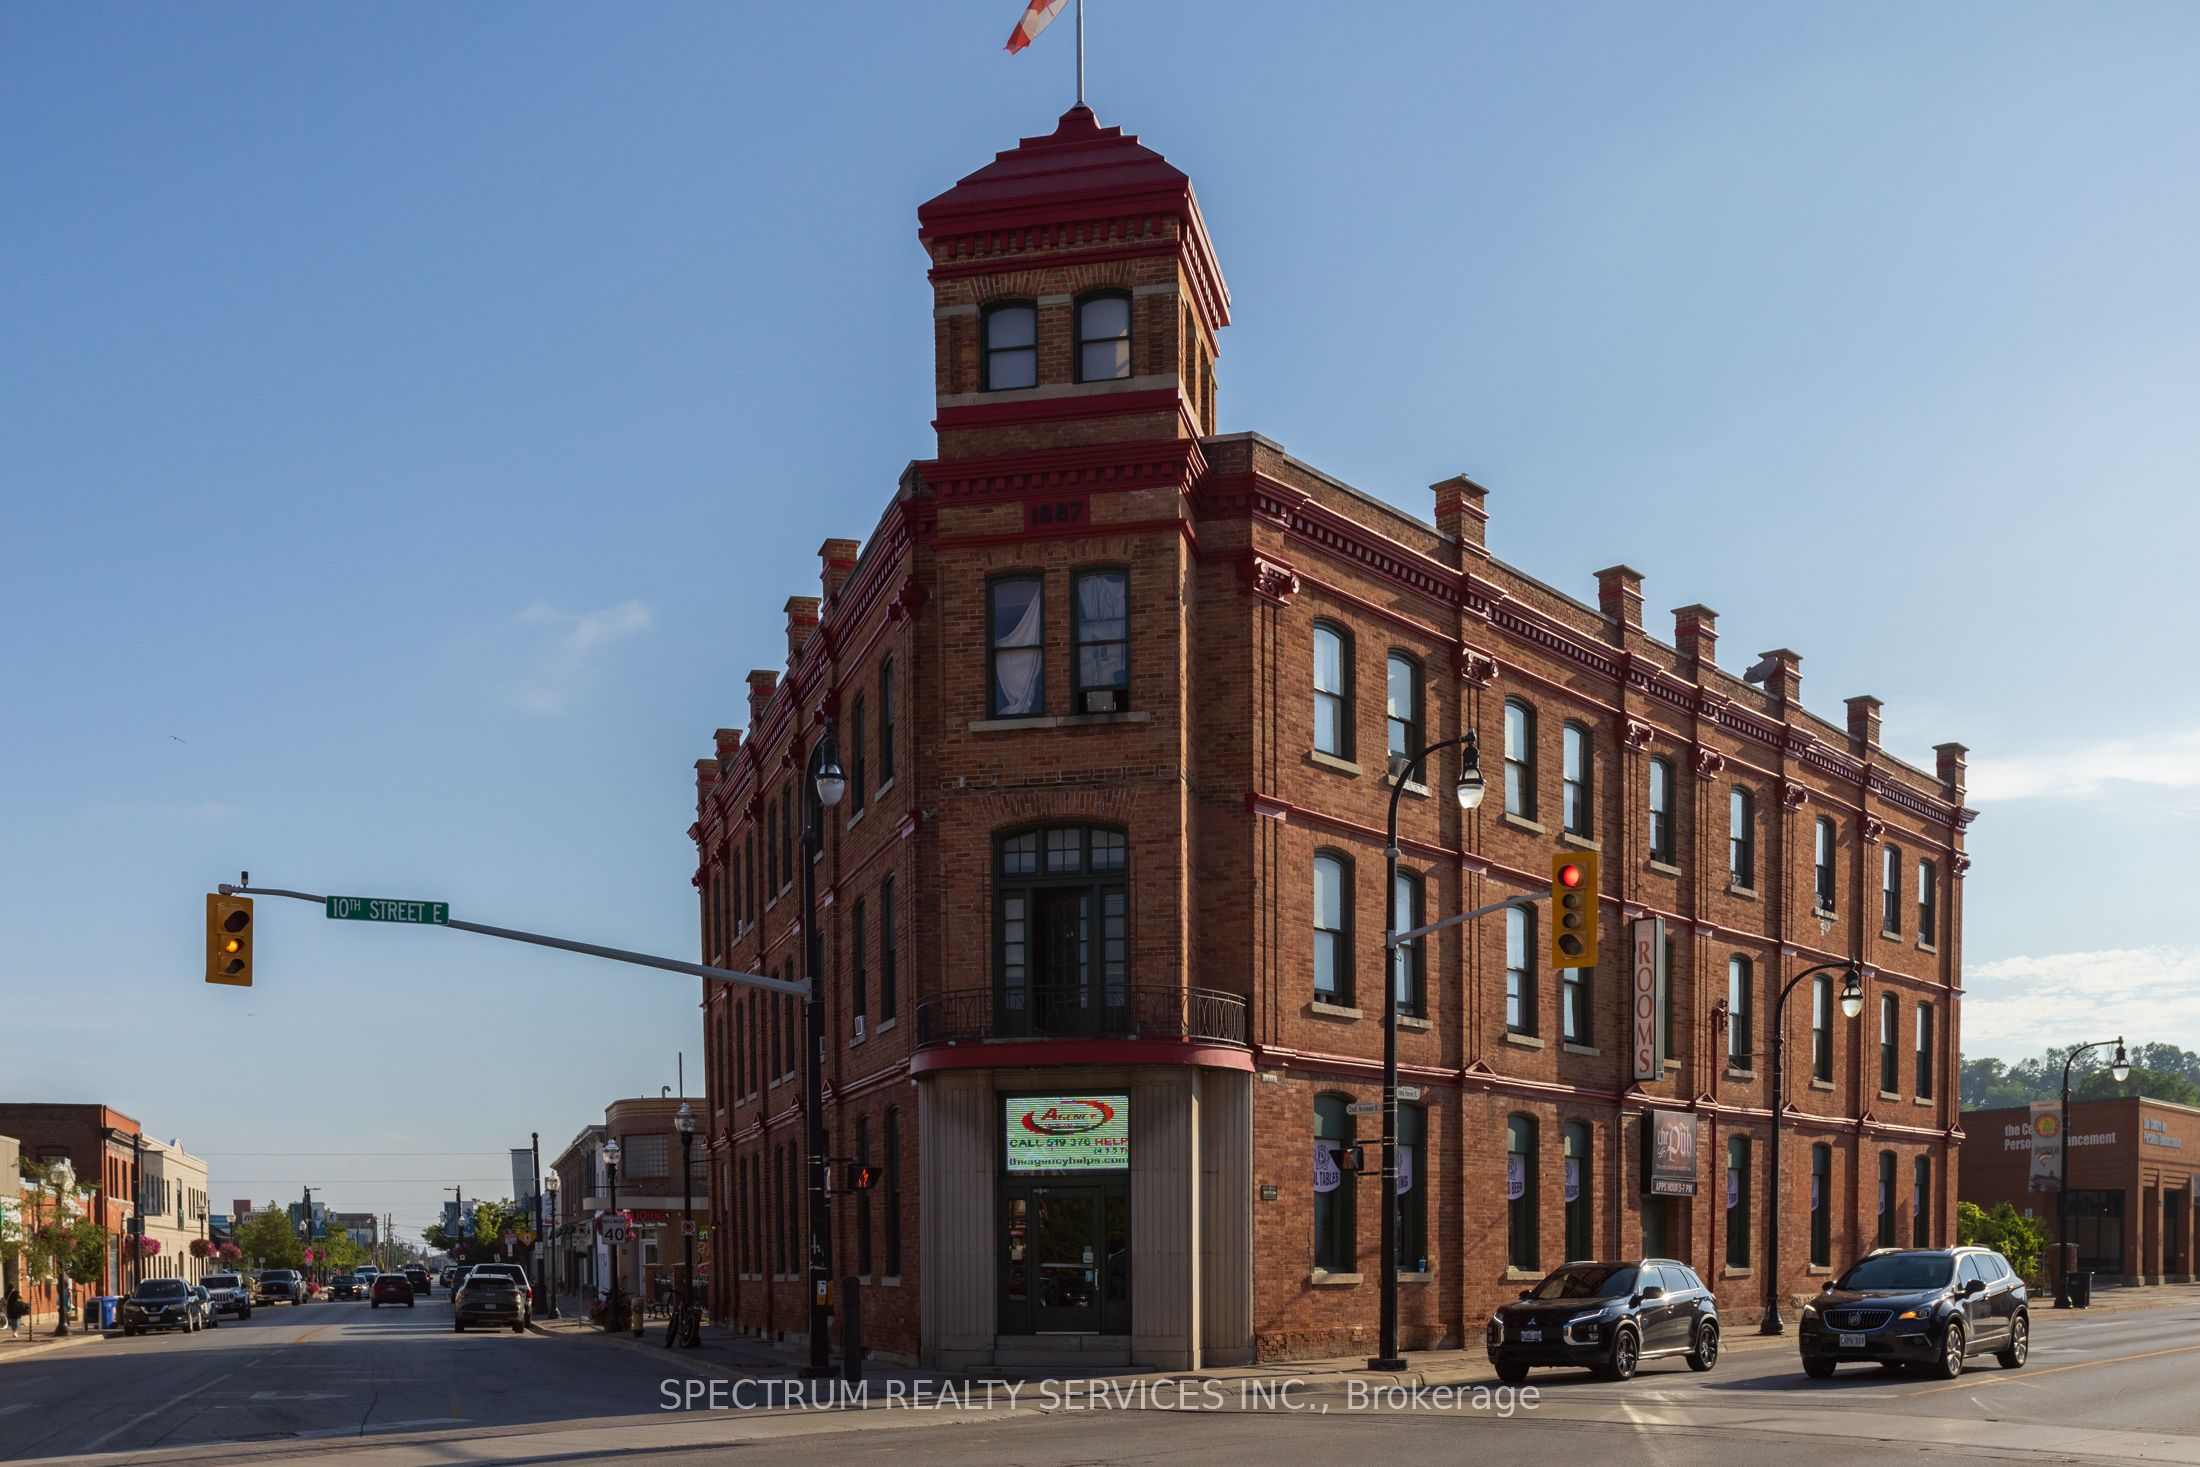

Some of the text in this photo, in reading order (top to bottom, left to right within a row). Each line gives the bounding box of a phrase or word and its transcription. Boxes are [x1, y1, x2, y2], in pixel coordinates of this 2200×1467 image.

[1030, 500, 1083, 526] 1887
[333, 898, 442, 923] 10TH STREET E
[1636, 940, 1654, 1073] ROOMS
[2004, 1124, 2020, 1137] the
[1009, 1138, 1128, 1148] CALL 519 376 HELP
[1667, 1122, 1692, 1162] Pub
[2004, 1138, 2032, 1151] Perso
[2067, 1131, 2117, 1147] ancement
[1009, 1157, 1128, 1167] theagencyhelps.com
[1319, 1171, 1339, 1187] TABLES
[1655, 1181, 1667, 1192] APPS
[1685, 1183, 1693, 1193] PM
[604, 1227, 624, 1241] 40
